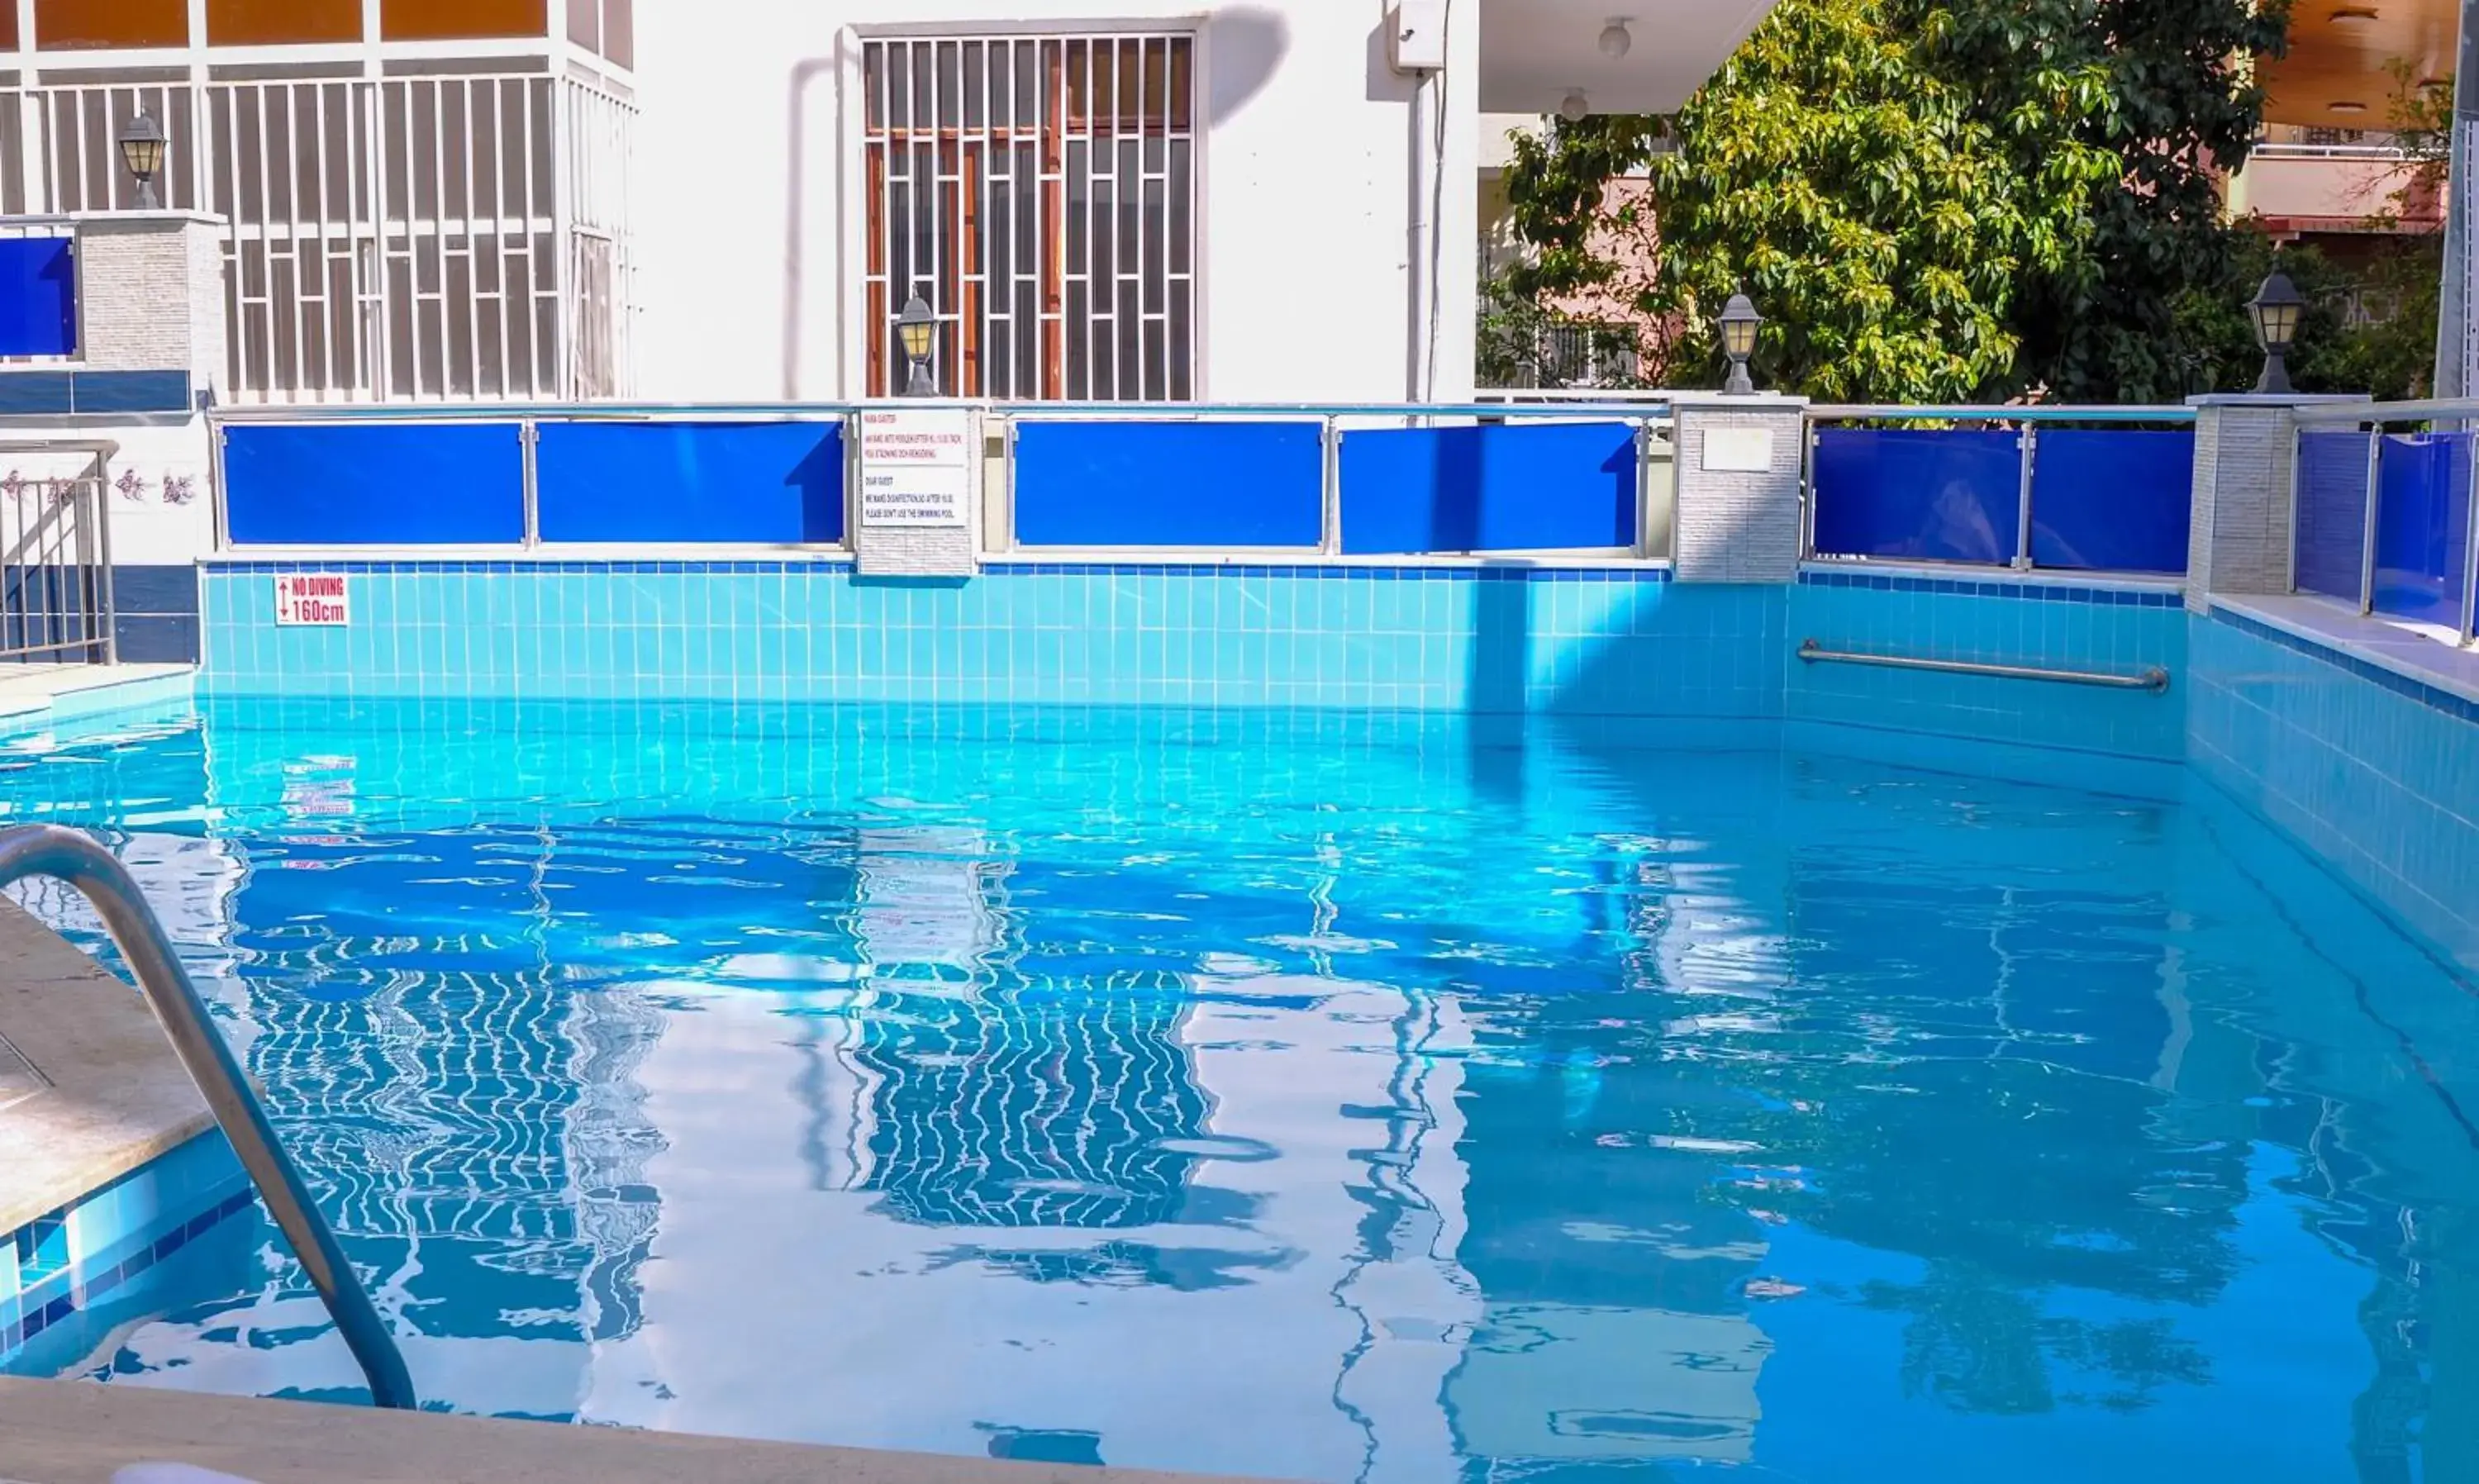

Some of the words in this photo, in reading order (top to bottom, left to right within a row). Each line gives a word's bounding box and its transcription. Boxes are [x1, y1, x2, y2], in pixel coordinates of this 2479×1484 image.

[292, 576, 306, 596] NO
[308, 576, 344, 596] DIVING
[293, 600, 345, 621] 160cm
